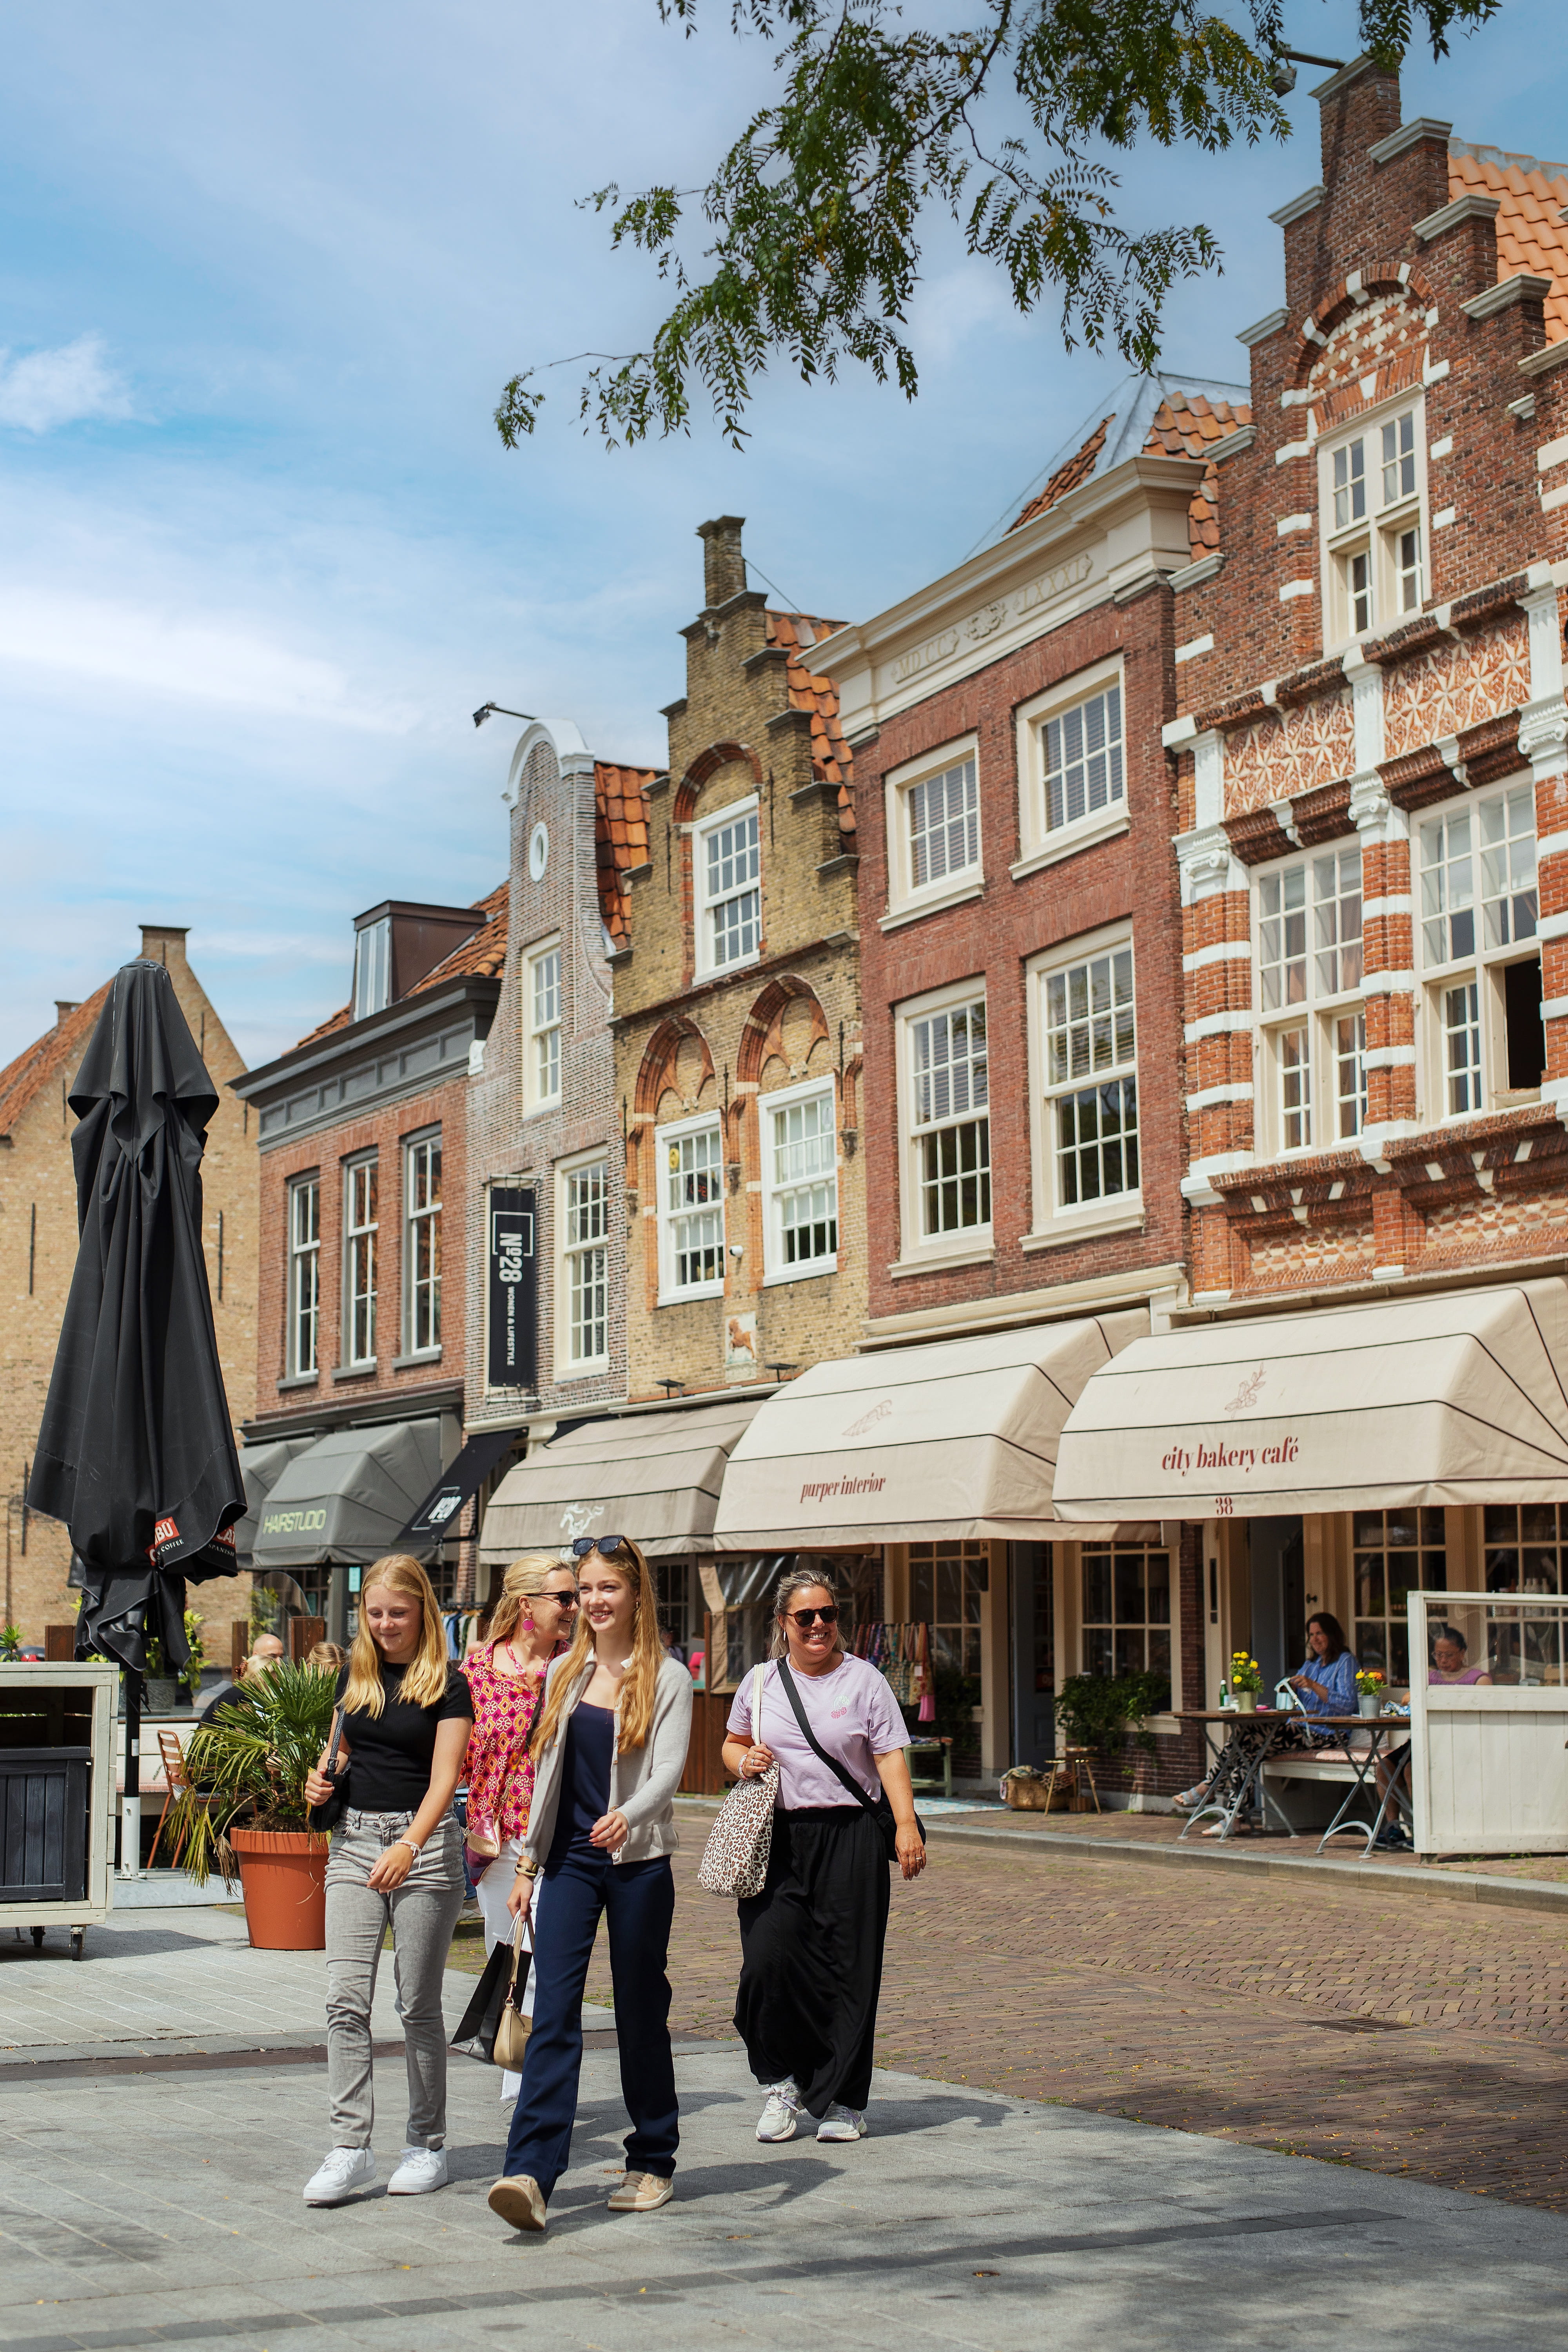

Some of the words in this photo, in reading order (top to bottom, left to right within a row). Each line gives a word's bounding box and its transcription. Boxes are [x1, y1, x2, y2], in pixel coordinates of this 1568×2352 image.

[507, 1325, 515, 1367] LIFESTYLE
[1162, 1446, 1194, 1476] city
[1196, 1442, 1259, 1472] bakery
[1262, 1436, 1299, 1464] café
[800, 1481, 840, 1503] purper
[840, 1472, 886, 1495] interior
[1215, 1496, 1233, 1515] 38
[161, 1538, 184, 1552] COFFEE
[208, 1543, 234, 1557] SPANISH
